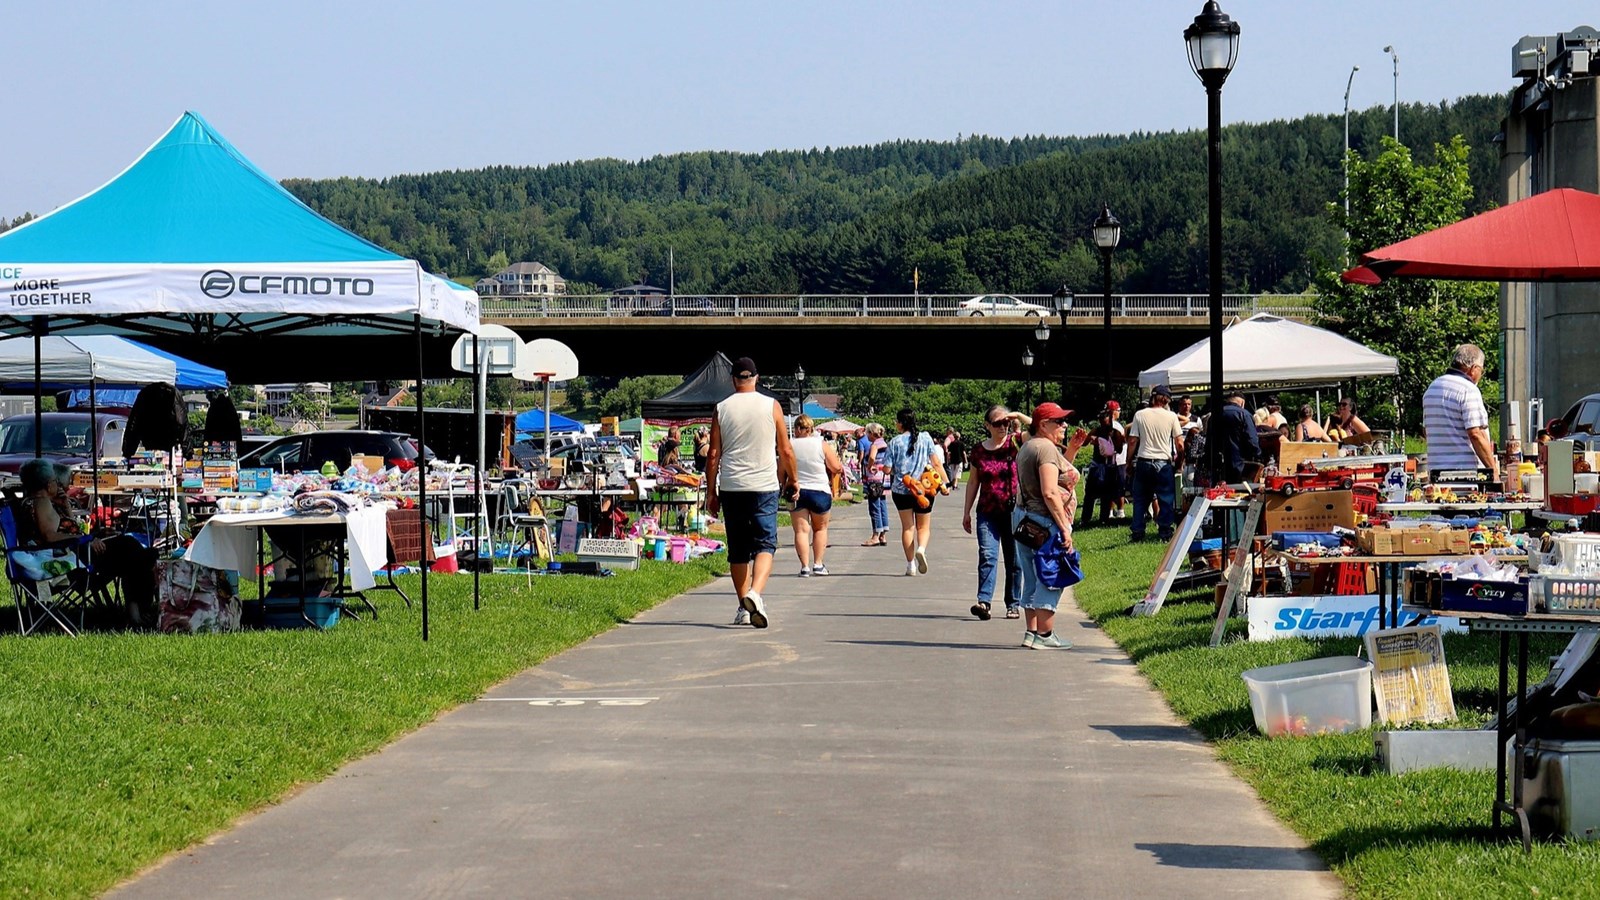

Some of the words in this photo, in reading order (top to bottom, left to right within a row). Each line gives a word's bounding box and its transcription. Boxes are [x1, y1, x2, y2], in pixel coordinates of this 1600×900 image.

[13, 279, 60, 291] MORE
[238, 276, 374, 296] CFMOTO
[9, 292, 92, 306] TOGETHER
